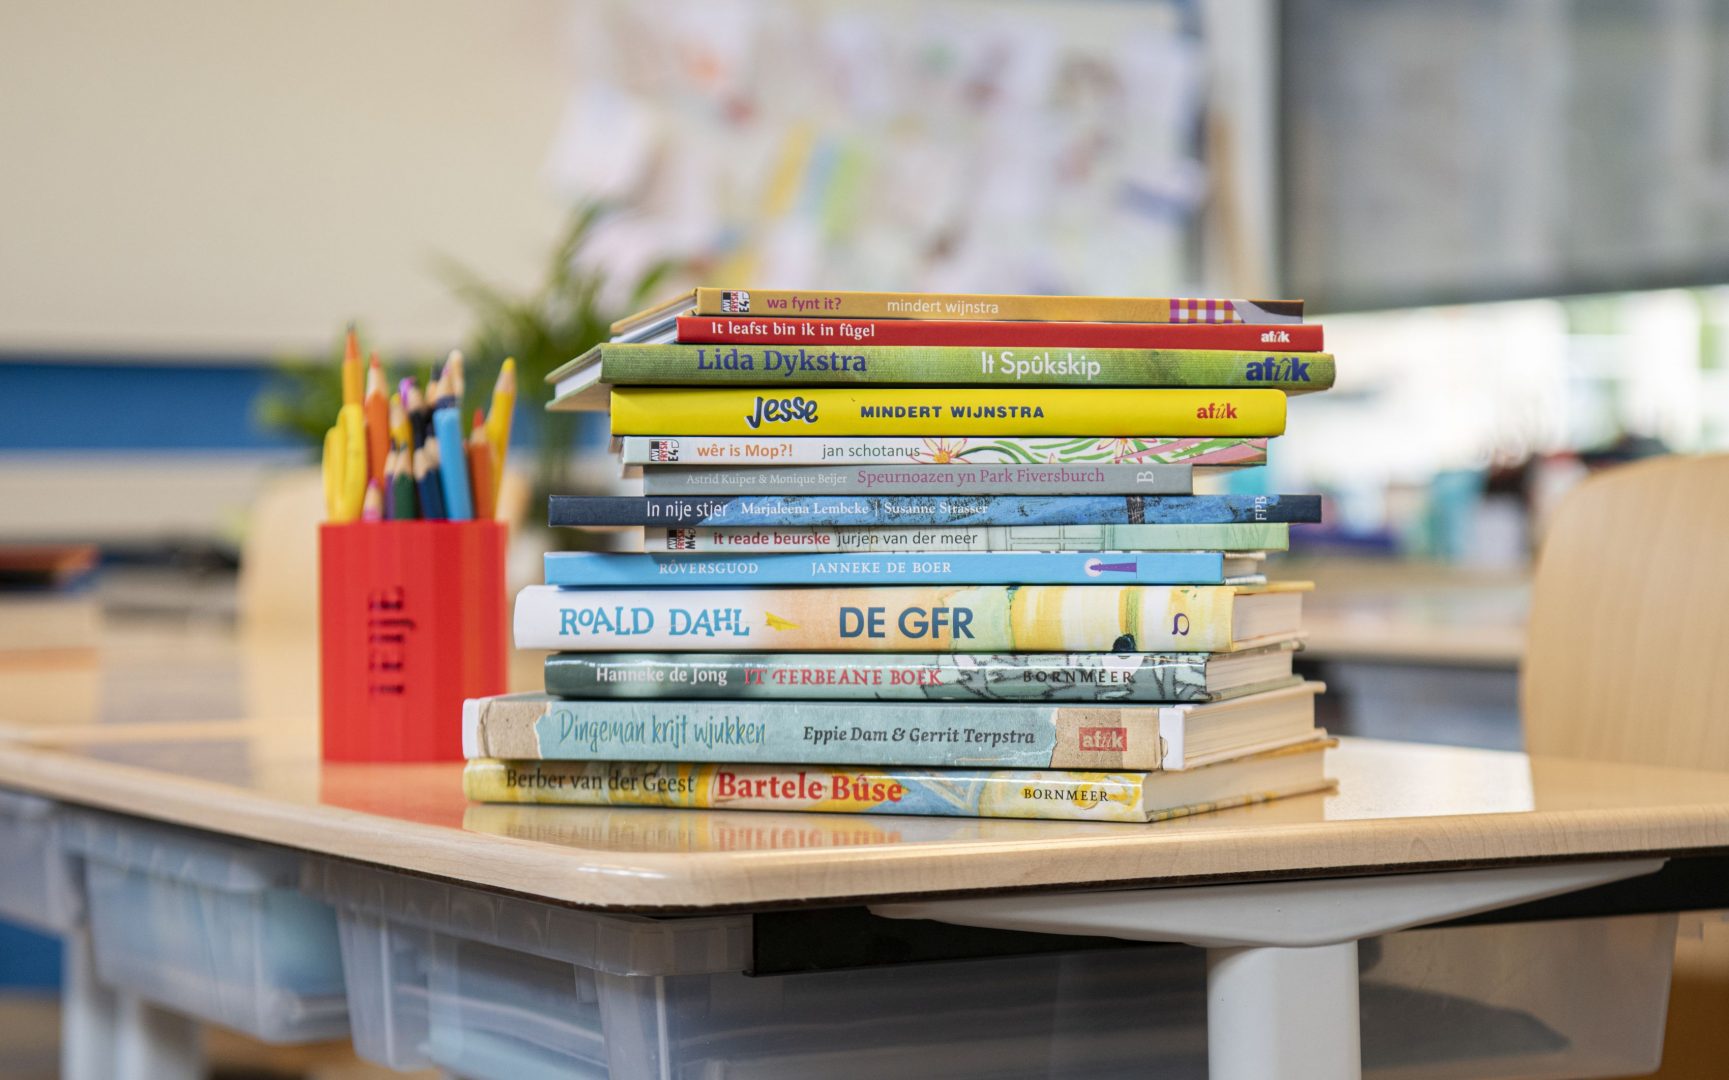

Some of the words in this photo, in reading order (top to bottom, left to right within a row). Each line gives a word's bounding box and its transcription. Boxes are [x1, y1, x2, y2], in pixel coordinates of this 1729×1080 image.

[723, 299, 731, 312] AVI
[731, 291, 739, 313] FRYSK
[738, 300, 750, 313] E4
[767, 298, 787, 310] wa
[791, 296, 820, 312] fynt
[824, 297, 841, 311] it?
[887, 299, 941, 313] mindert
[946, 300, 999, 316] wijnstra
[712, 322, 724, 335] It
[728, 321, 768, 336] leafst
[774, 322, 796, 336] bin
[801, 322, 816, 337] ik
[820, 323, 834, 337] in
[839, 322, 875, 340] fûgel
[697, 349, 754, 372] Lida
[764, 350, 867, 377] Dykstra
[981, 352, 994, 375] It
[1001, 351, 1101, 380] Spûkskip
[1246, 357, 1311, 382] afûk
[861, 405, 942, 419] MINDERT
[951, 405, 1044, 419] WIJNSTRA
[1196, 403, 1237, 420] afûk
[651, 448, 659, 461] AVI
[659, 441, 668, 462] FRYSK
[668, 448, 679, 462] E4
[697, 443, 726, 458] wêr
[729, 443, 741, 458] is
[745, 443, 793, 462] Mop?!
[822, 444, 844, 460] jan
[848, 443, 921, 458] schotanus
[686, 473, 718, 485] Astrid
[722, 473, 756, 488] Kuiper
[758, 474, 767, 485] &
[770, 473, 815, 488] Monique
[818, 473, 847, 488] Beijer
[857, 469, 954, 488] Speurnoazen
[957, 472, 976, 487] yn
[980, 468, 1013, 483] Park
[1017, 468, 1104, 483] Fiversburch
[1136, 470, 1154, 484] B
[647, 501, 660, 518] In
[666, 501, 692, 522] nije
[696, 501, 728, 522] stjer
[741, 502, 809, 518] Marjaleena
[813, 502, 869, 515] Lembcke
[884, 502, 935, 515] Susanne
[939, 502, 988, 515] Strasser
[1255, 495, 1267, 521] FPB
[685, 533, 696, 550] M4
[713, 532, 724, 545] it
[728, 532, 769, 545] reade
[774, 532, 831, 545] beurske
[837, 532, 879, 547] jurjen
[882, 534, 908, 546] van
[911, 532, 935, 546] der
[939, 534, 978, 545] meer
[659, 559, 758, 575] RÔVERSGUOD
[811, 561, 880, 575] JANNEKE
[887, 561, 906, 574] DE
[912, 561, 952, 573] BOER
[559, 607, 654, 636] ROALD
[669, 608, 750, 637] DAHL
[839, 607, 885, 638] DE
[898, 607, 975, 639] GFR
[596, 666, 664, 682] Hanneke
[669, 667, 687, 682] de
[691, 669, 727, 686] Jong
[744, 669, 767, 685] IT
[891, 669, 944, 686] BOEK
[1023, 670, 1132, 683] BORNMEER
[555, 709, 645, 752] Dingeman
[652, 715, 688, 748] krijt
[695, 715, 766, 749] wjukken
[803, 726, 847, 745] Eppie
[850, 727, 888, 742] Dam
[891, 727, 906, 742] &
[909, 727, 960, 743] Gerrit
[964, 728, 1035, 748] Terpstra
[506, 769, 568, 789] Berber
[572, 775, 601, 790] van
[608, 773, 636, 791] der
[642, 773, 694, 794] Geest
[717, 772, 823, 800] Bartele
[831, 774, 903, 803] Bûse
[1024, 788, 1108, 802] BORNMEER
